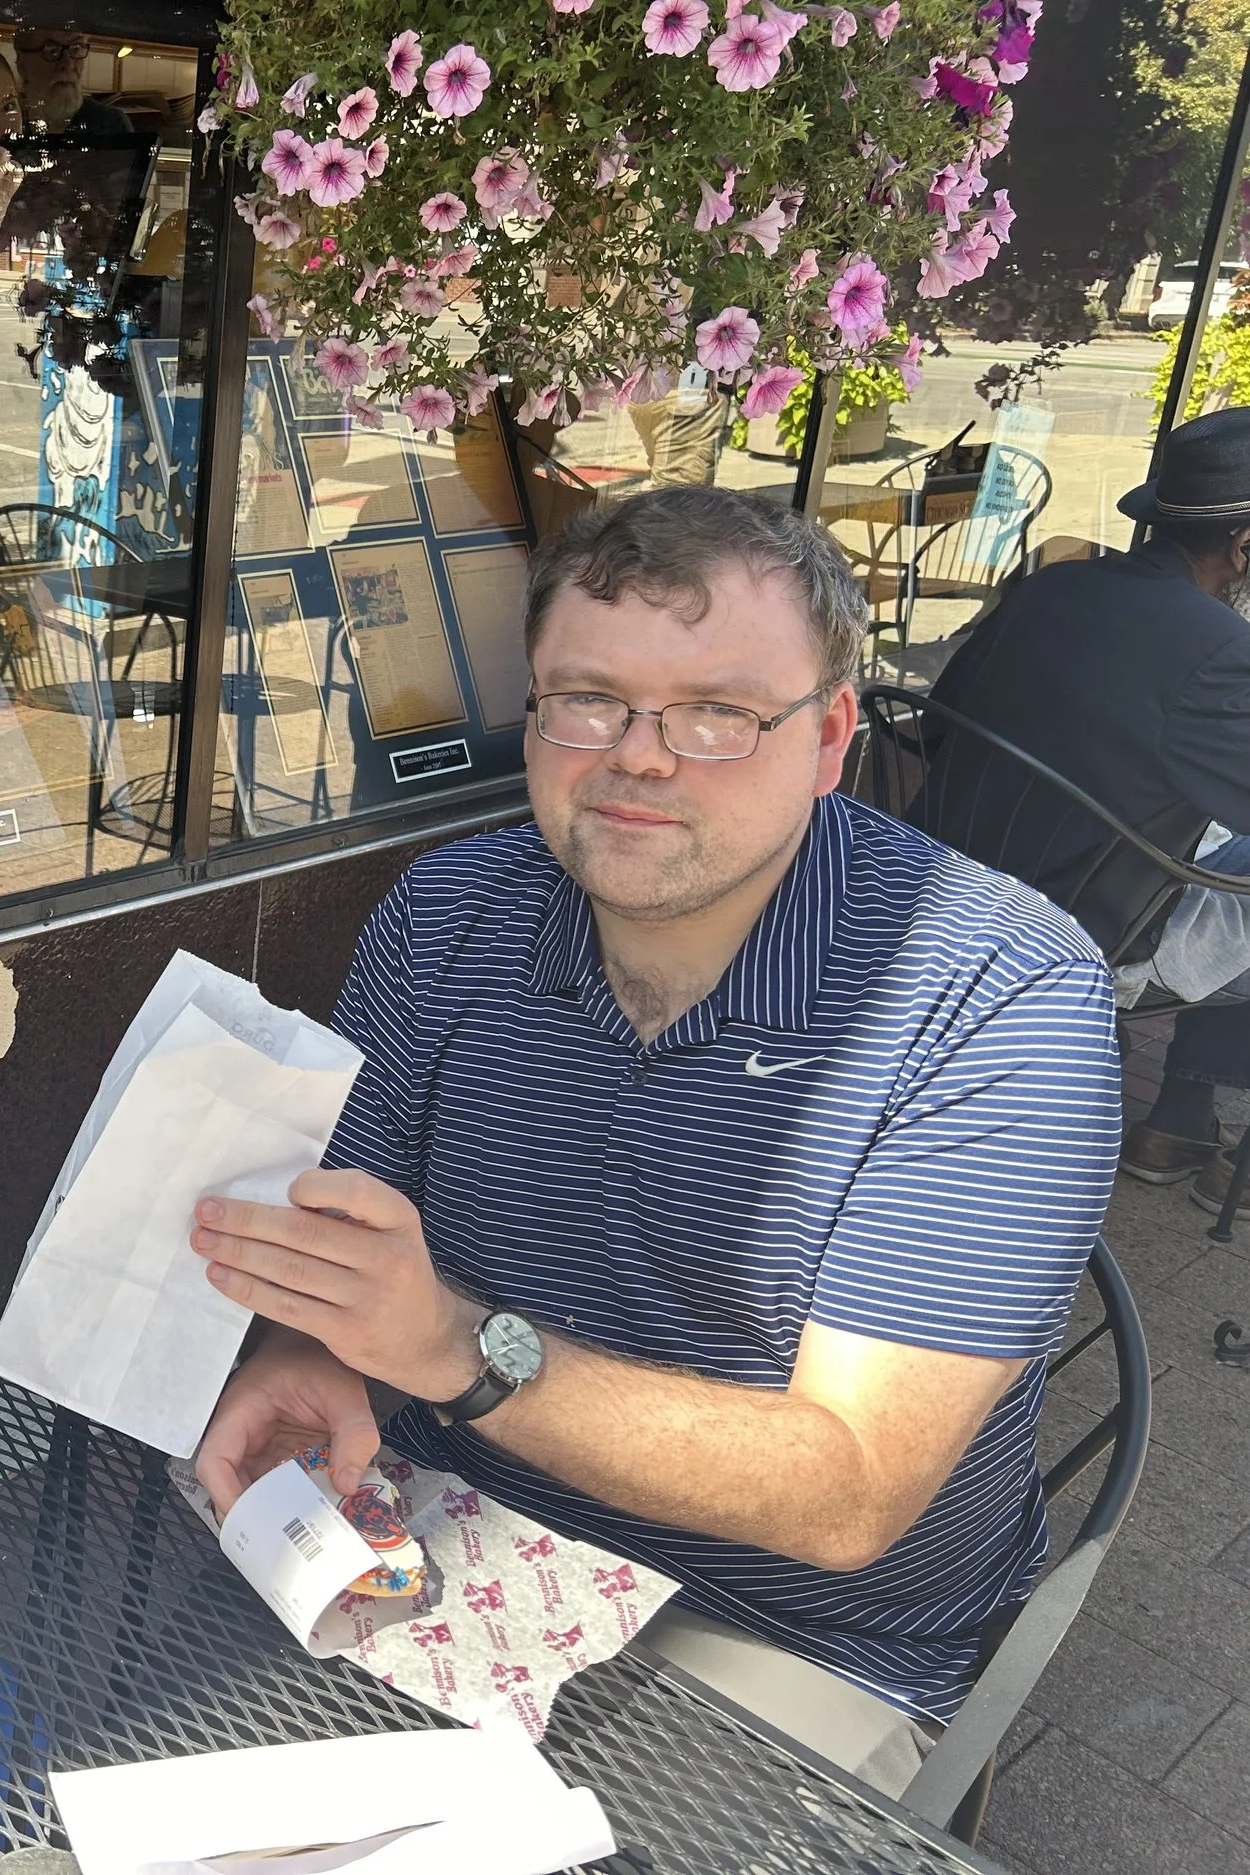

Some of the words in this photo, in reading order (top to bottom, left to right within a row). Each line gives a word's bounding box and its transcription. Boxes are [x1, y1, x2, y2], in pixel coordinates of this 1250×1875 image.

[399, 753, 428, 766] Bennison's
[458, 1520, 477, 1568] Bennison's
[470, 1529, 484, 1562] Bakery
[533, 1562, 555, 1615] Bennison's
[547, 1569, 563, 1605] Bakery
[427, 1648, 452, 1707] Bennison's
[442, 1657, 458, 1694] Bakery
